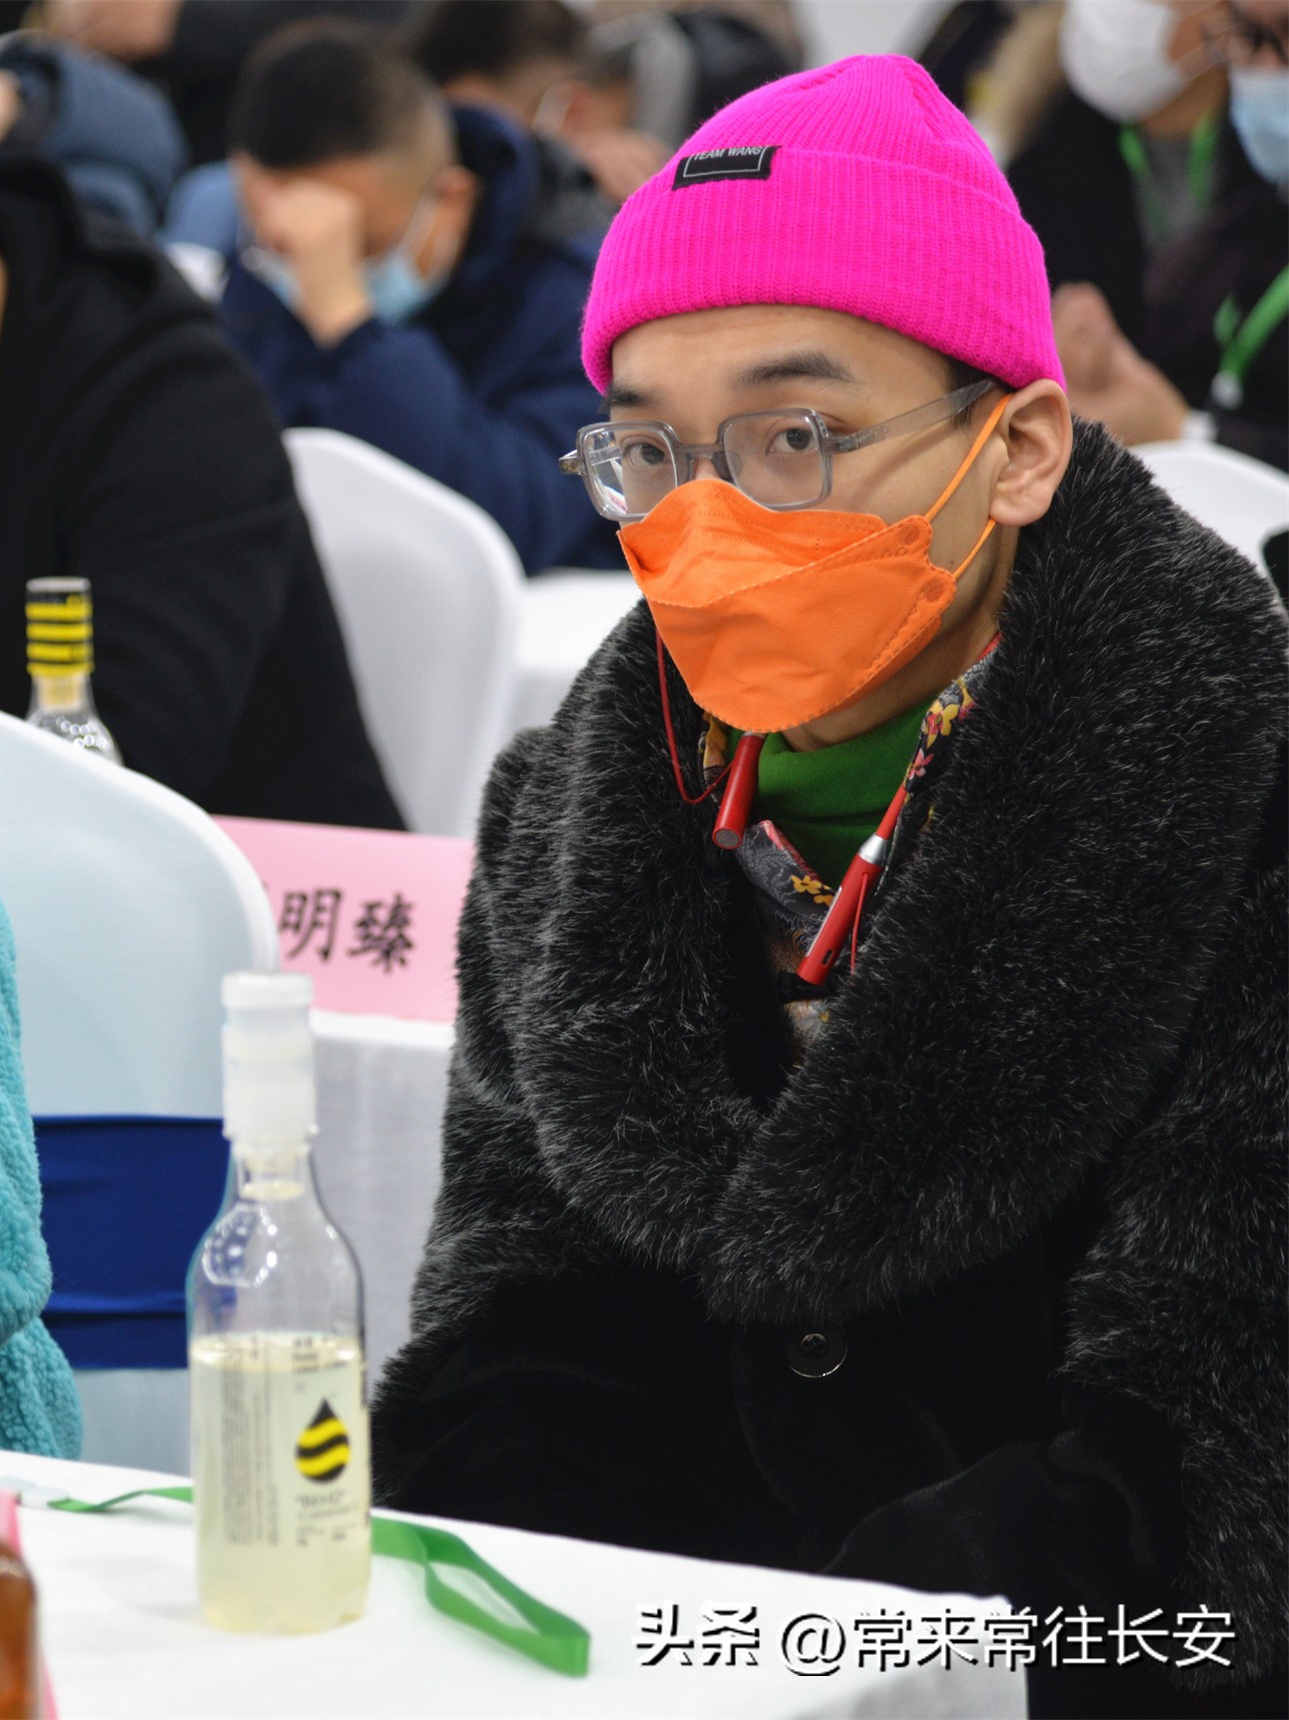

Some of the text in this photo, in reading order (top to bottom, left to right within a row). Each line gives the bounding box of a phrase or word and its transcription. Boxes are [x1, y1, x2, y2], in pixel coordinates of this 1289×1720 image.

[694, 147, 762, 161] TEAM WANG
[263, 880, 416, 976] 明臻
